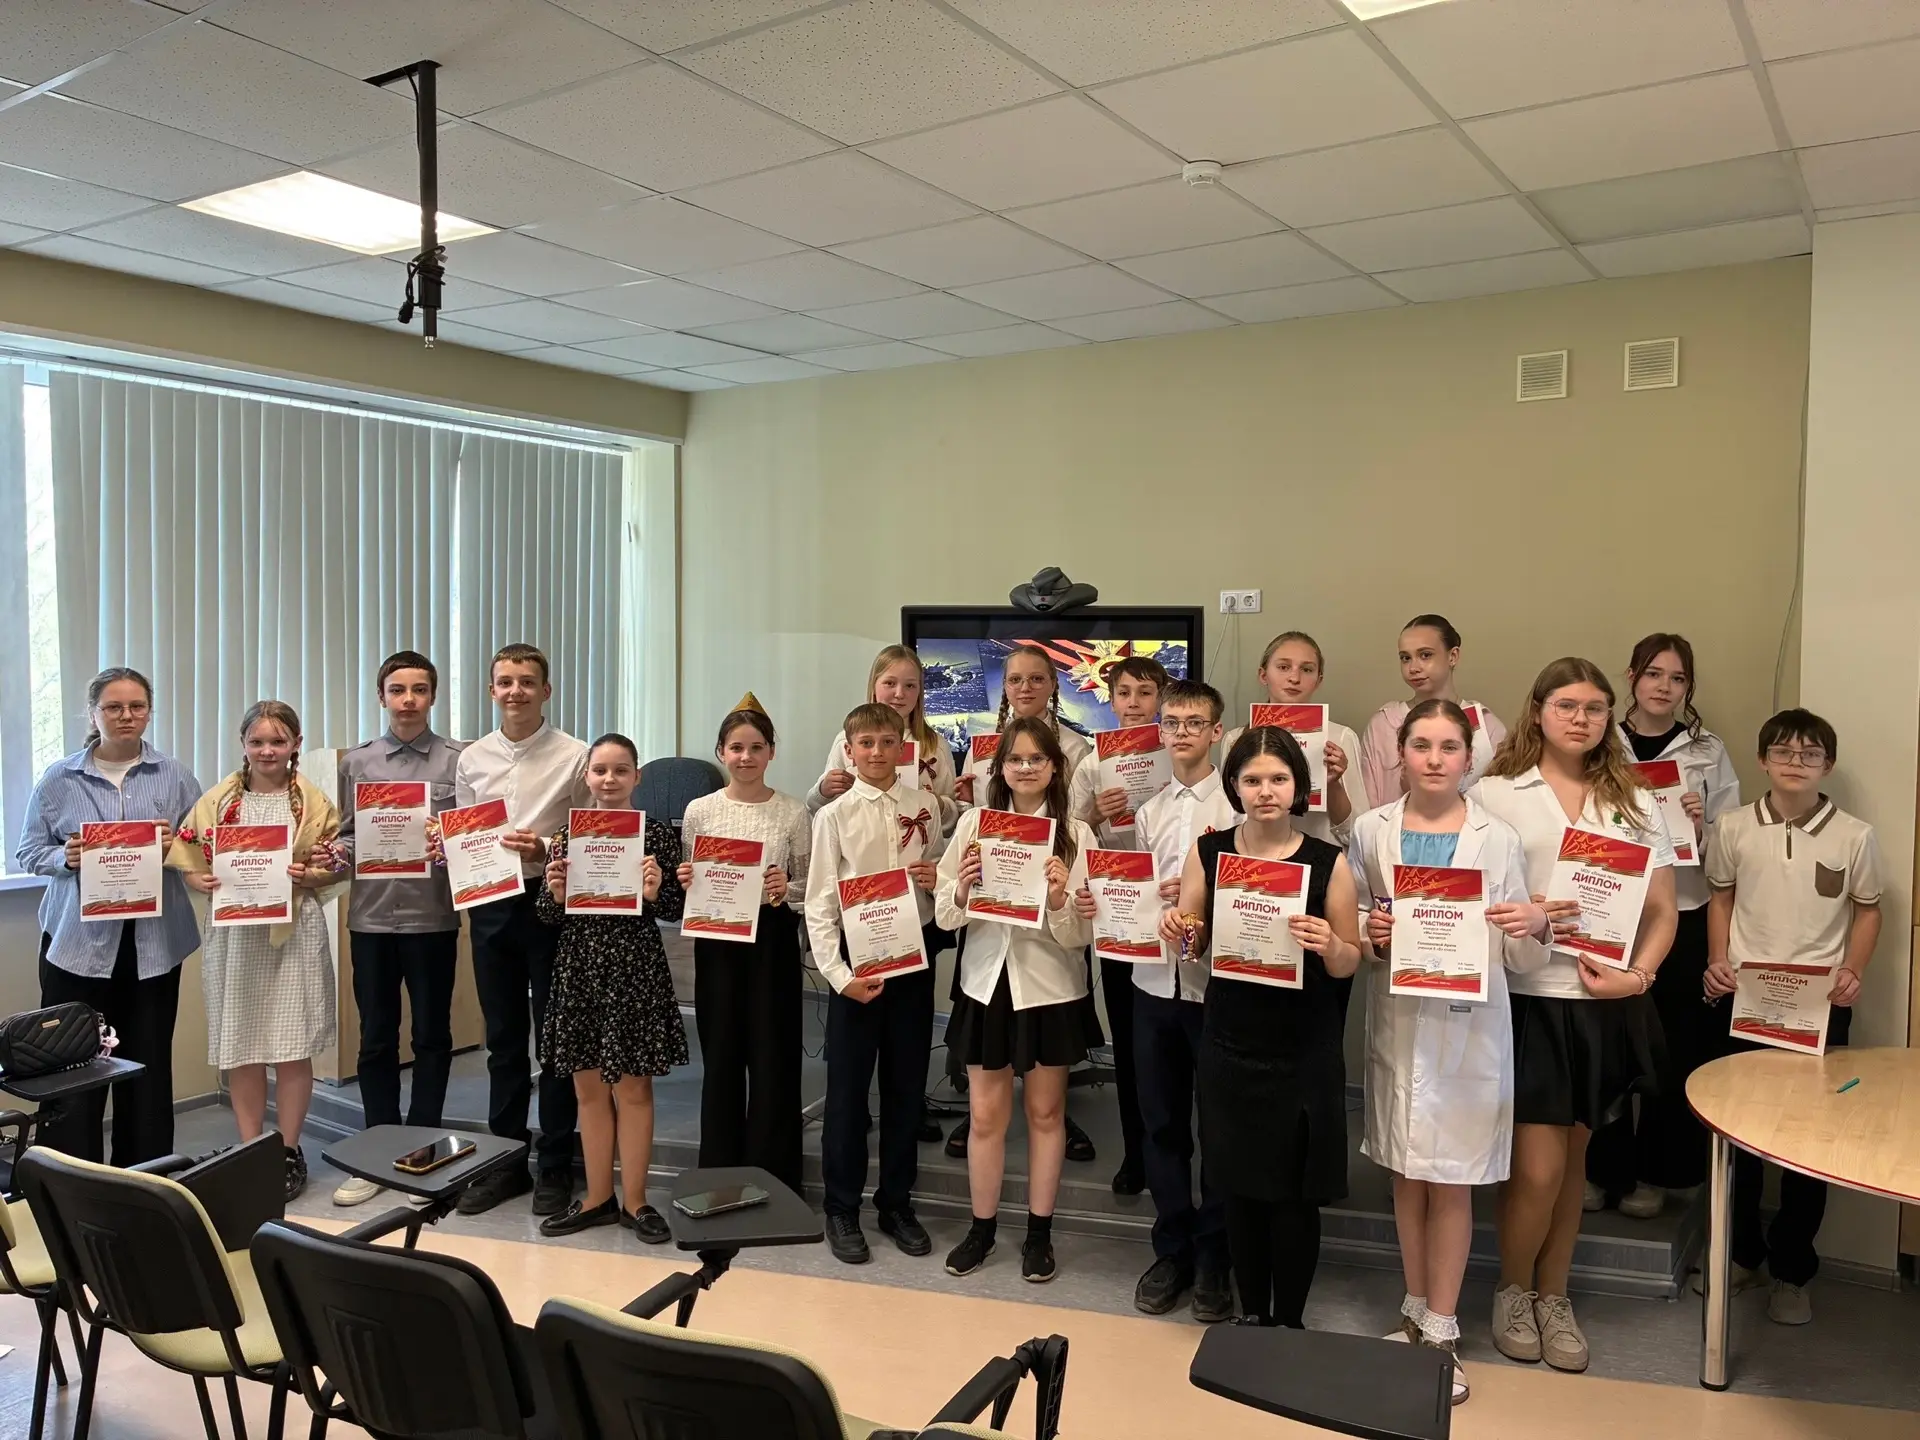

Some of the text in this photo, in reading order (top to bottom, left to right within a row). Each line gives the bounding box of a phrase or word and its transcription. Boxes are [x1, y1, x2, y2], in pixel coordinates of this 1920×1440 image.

[1116, 760, 1154, 773] ДИПЛОМ
[371, 816, 411, 824] ДИПЛОМ
[461, 835, 499, 850] ДИПЛОМ
[99, 854, 141, 864] ДИПЛОМ
[990, 848, 1032, 860] ДИПЛОМ
[231, 858, 272, 867] ДИПЛОМ
[996, 858, 1024, 866] УЧАСТНИКА
[705, 870, 744, 880] ДИПЛОМ
[1572, 872, 1622, 891] ДИПЛОМ
[1103, 887, 1140, 897] ДИПЛОМ
[1578, 884, 1612, 897] УЧАСТНИКА
[1233, 900, 1280, 915] ДИПЛОМ
[860, 906, 898, 921] ДИПЛОМ
[1240, 911, 1272, 921] УЧАСТНИКА
[1412, 909, 1463, 920] ДИПЛОМ
[866, 917, 893, 926] УЧАСТНИКА
[1420, 920, 1456, 928] УЧАСТНИКА
[1757, 974, 1808, 986] ДИПЛОМ
[1765, 982, 1799, 990] УЧАСТНИКА
